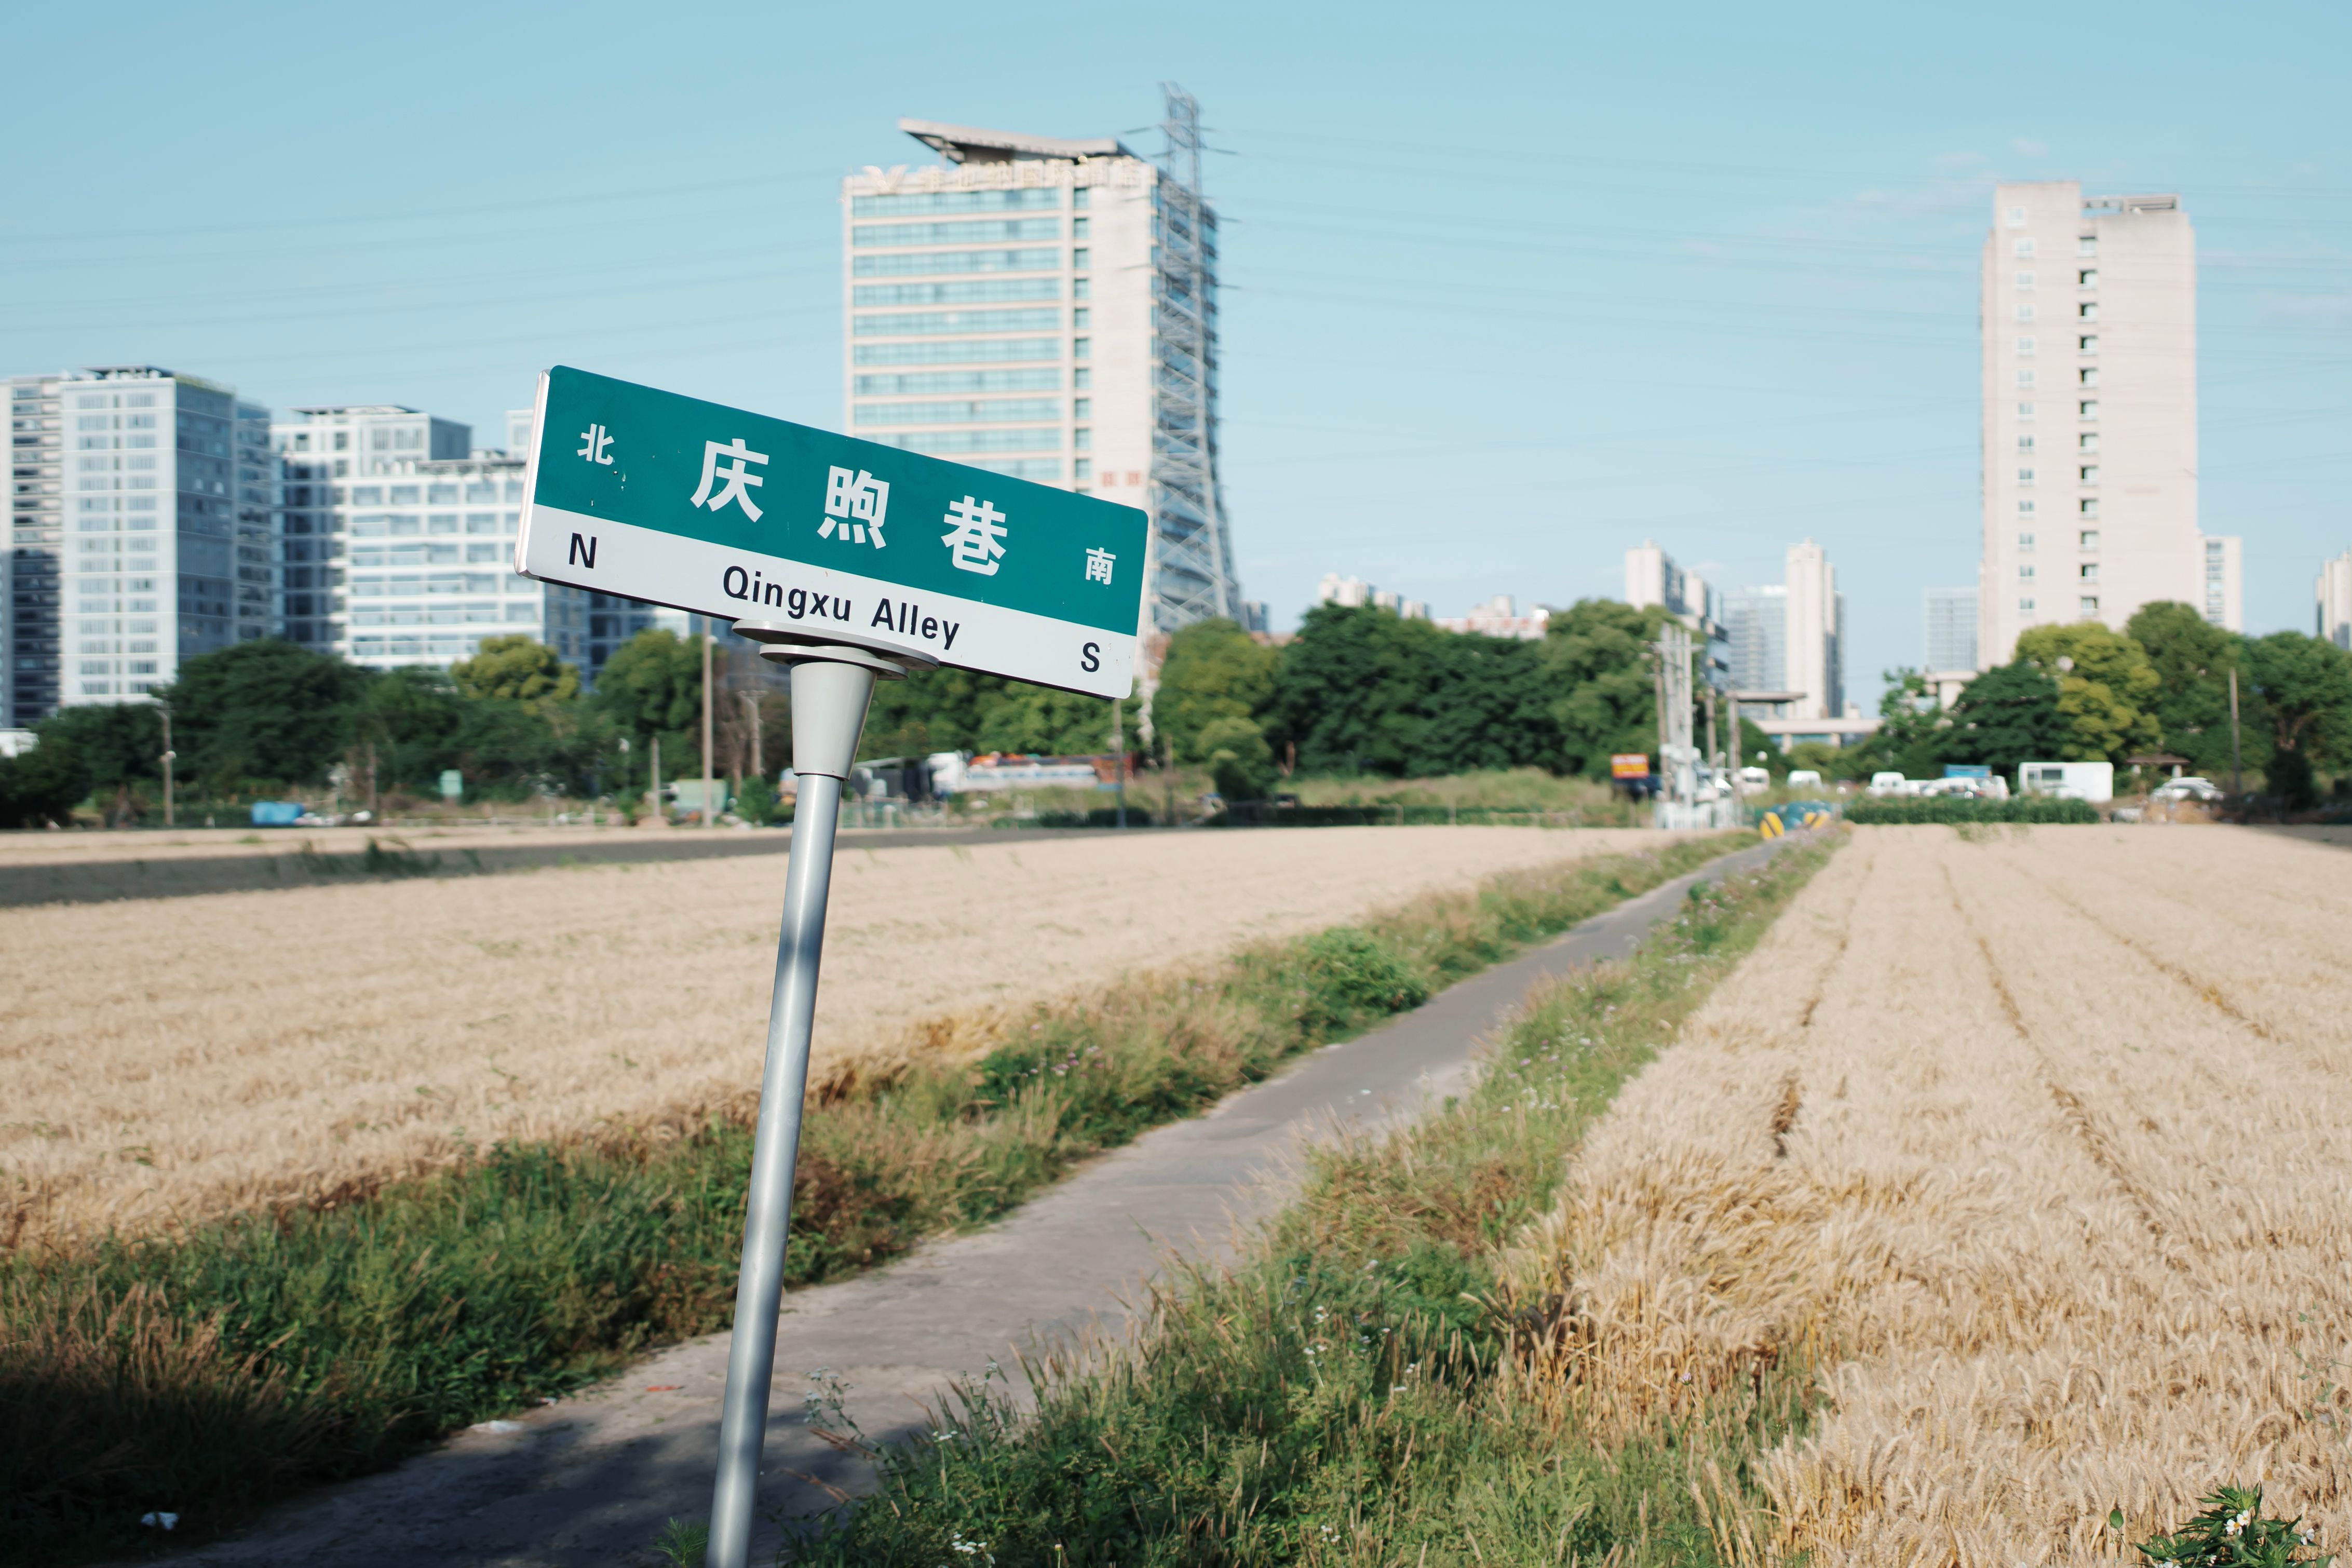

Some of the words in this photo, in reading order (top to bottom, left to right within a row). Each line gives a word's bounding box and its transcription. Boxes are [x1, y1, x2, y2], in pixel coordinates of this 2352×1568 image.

[577, 423, 615, 466] 北
[690, 438, 1008, 577] 庆煦巷
[569, 532, 597, 569] N
[1085, 547, 1116, 585] 南
[723, 565, 851, 622] Qingxu
[870, 597, 961, 651] Alley
[1080, 642, 1101, 673] S
